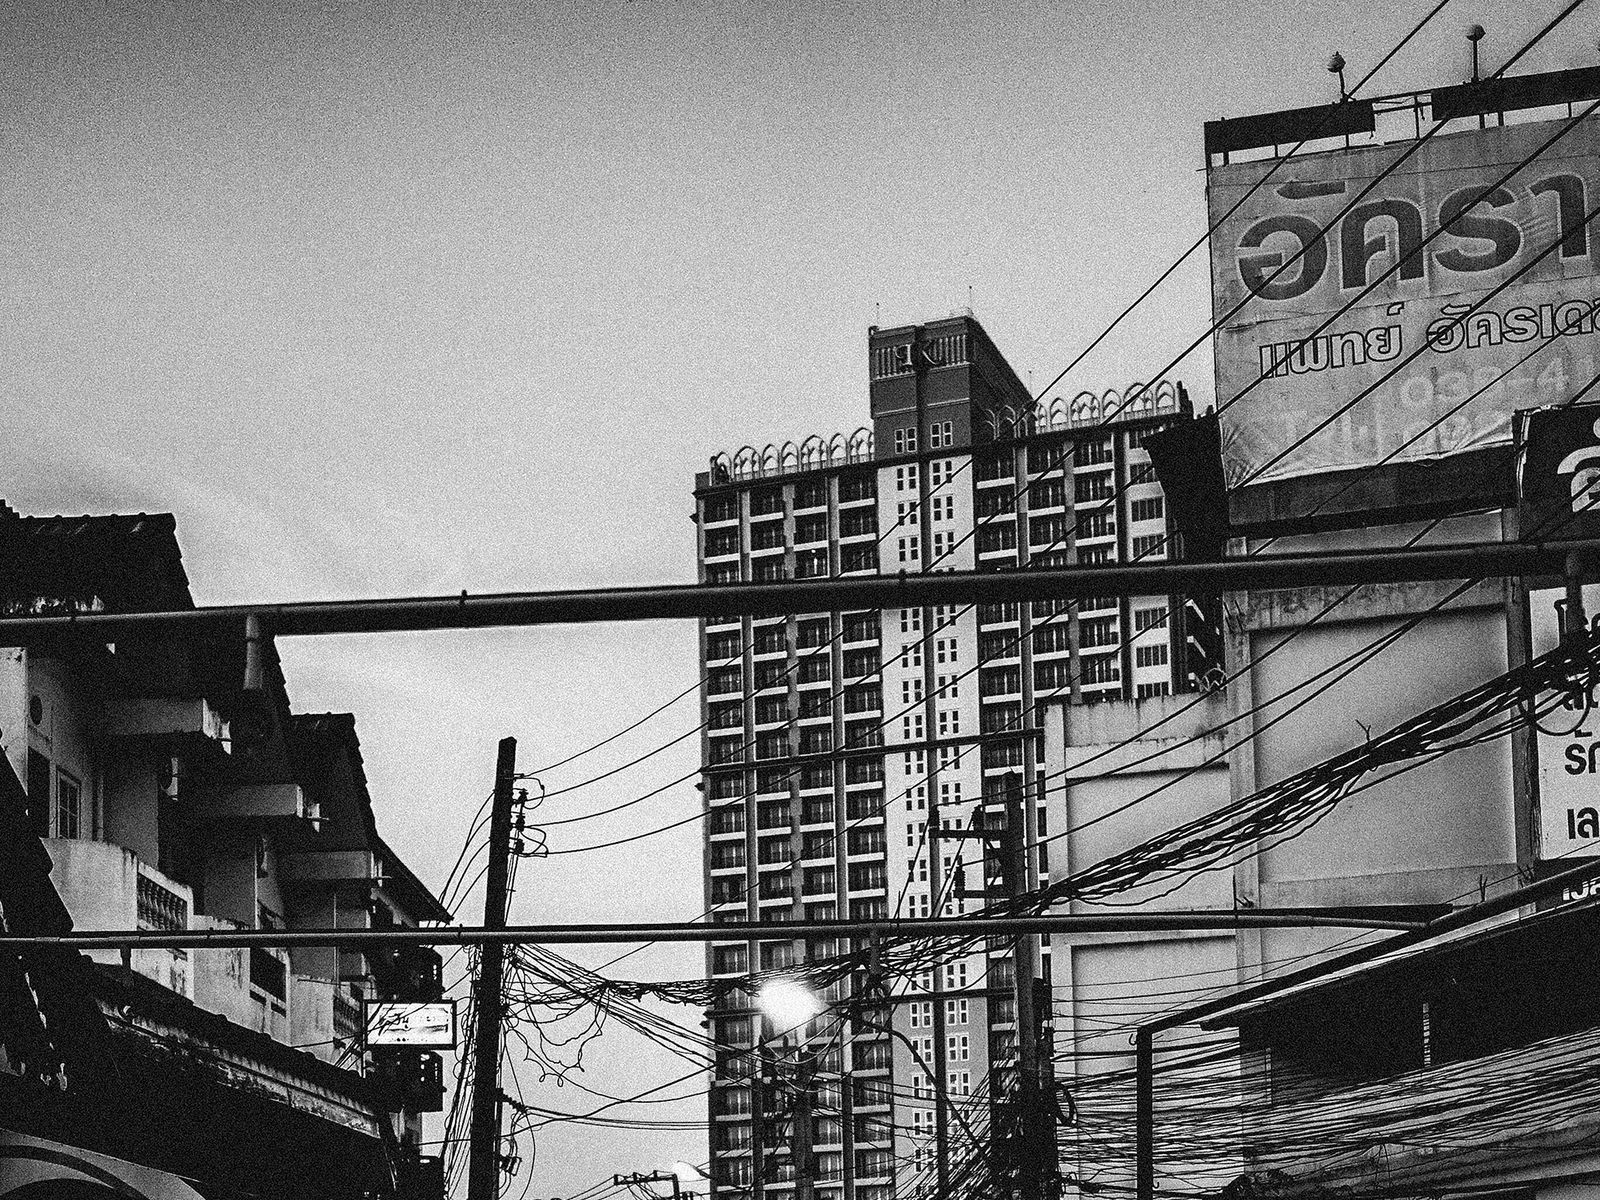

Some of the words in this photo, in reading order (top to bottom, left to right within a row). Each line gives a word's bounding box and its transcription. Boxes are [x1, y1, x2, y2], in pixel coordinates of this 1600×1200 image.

[1237, 172, 1590, 302] อัครา
[1259, 302, 1405, 378] แพทย์
[1426, 297, 1600, 354] อัครเด
